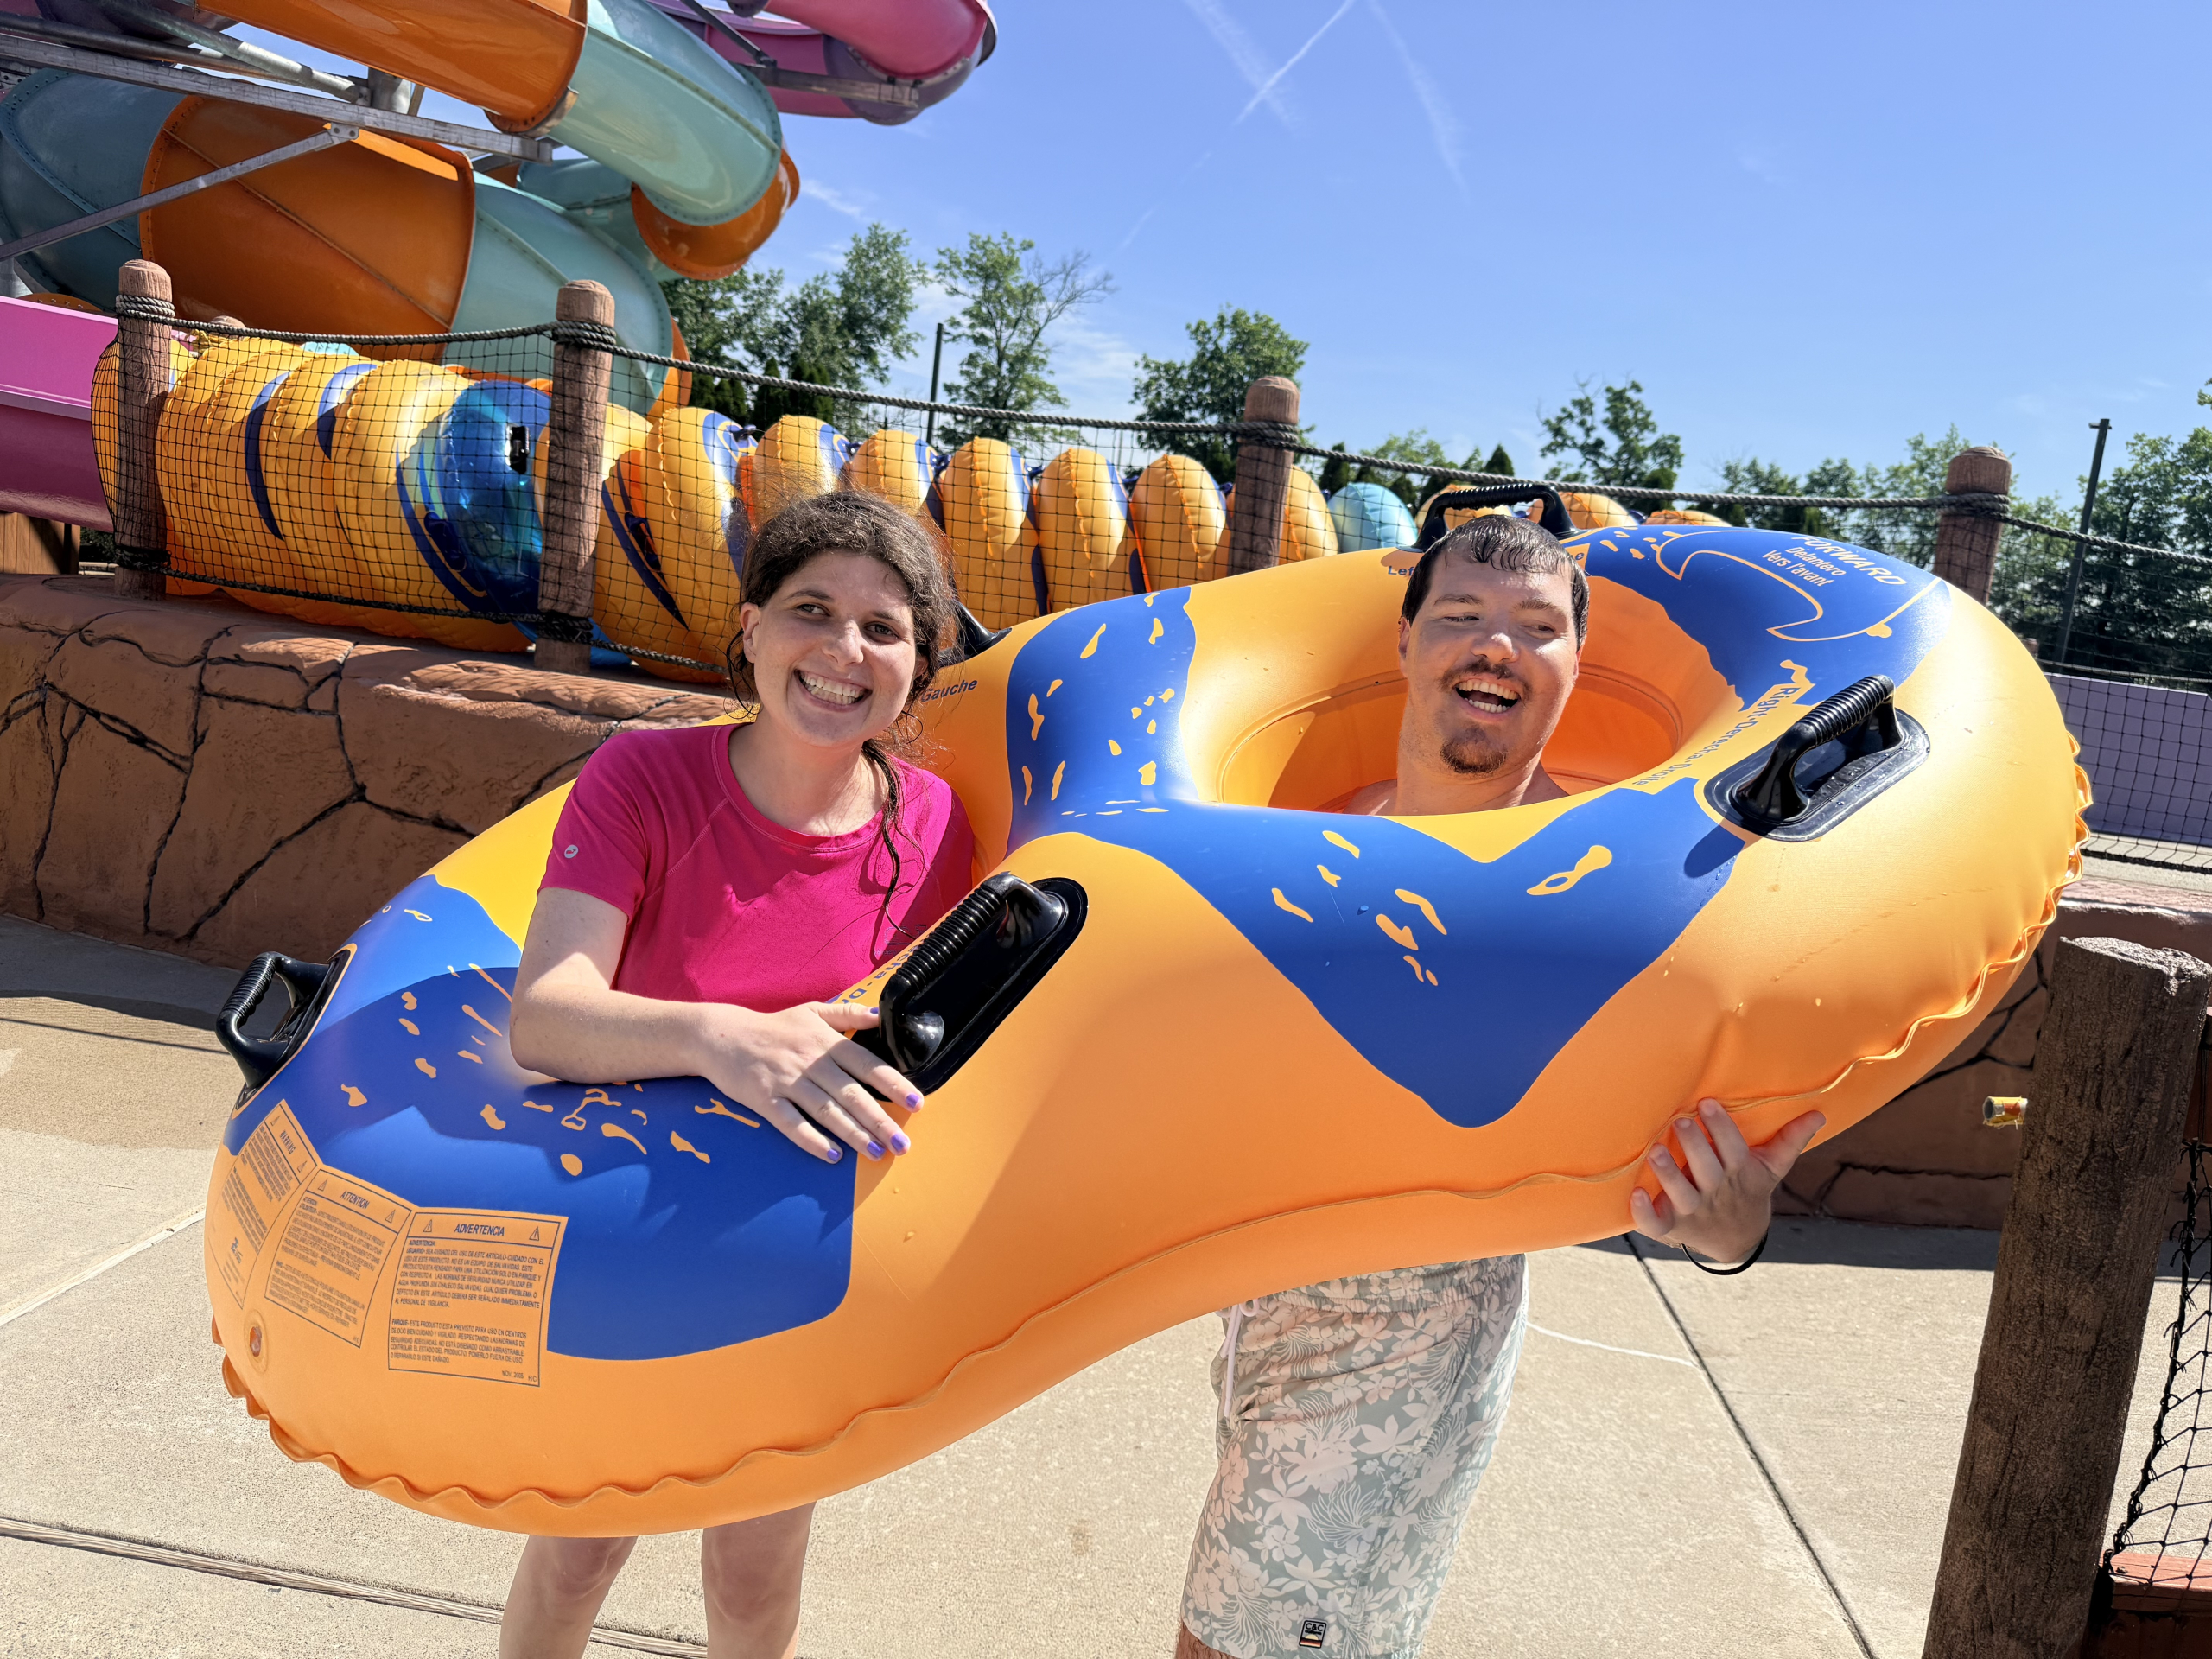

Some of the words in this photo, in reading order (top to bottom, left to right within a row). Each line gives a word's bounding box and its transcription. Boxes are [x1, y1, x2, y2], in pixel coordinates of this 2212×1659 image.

[1388, 565, 1415, 576] Lef
[1763, 550, 1790, 567] Vers
[1790, 563, 1834, 587] l'avant
[1785, 547, 1847, 576] Delantero
[1791, 536, 1906, 585] FORWARD
[921, 679, 978, 702] Gauche
[279, 1129, 296, 1154] WARNING
[340, 1190, 370, 1210] ATTENTION
[454, 1223, 505, 1236] ADVERTENCIA
[1305, 1623, 1324, 1631] C&C
